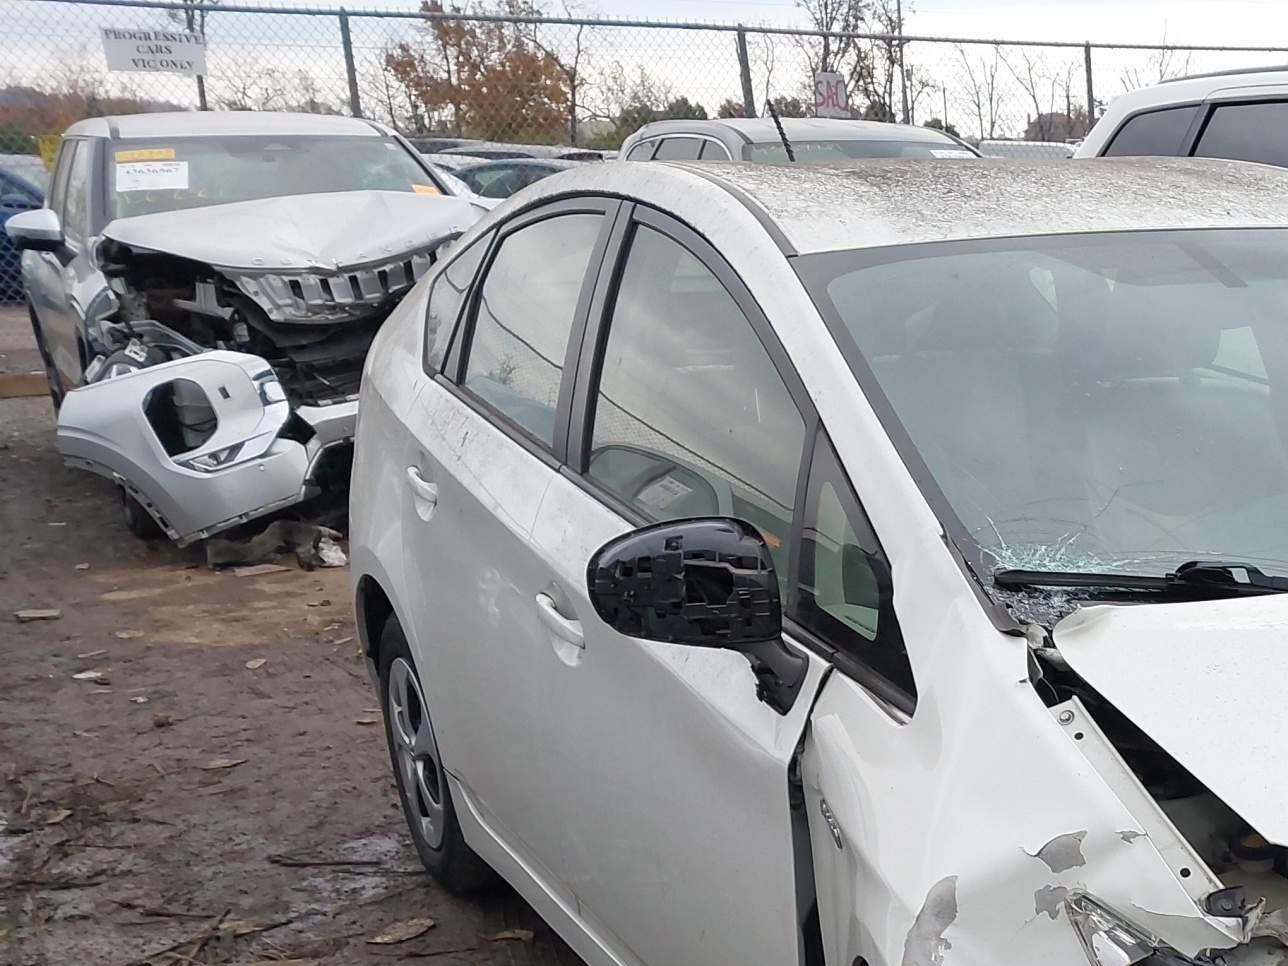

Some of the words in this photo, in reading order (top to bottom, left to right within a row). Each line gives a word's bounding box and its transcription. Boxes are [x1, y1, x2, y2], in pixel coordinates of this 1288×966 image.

[104, 29, 201, 45] PROGRESSIVE
[136, 44, 173, 55] CARS
[159, 59, 195, 70] ONLY
